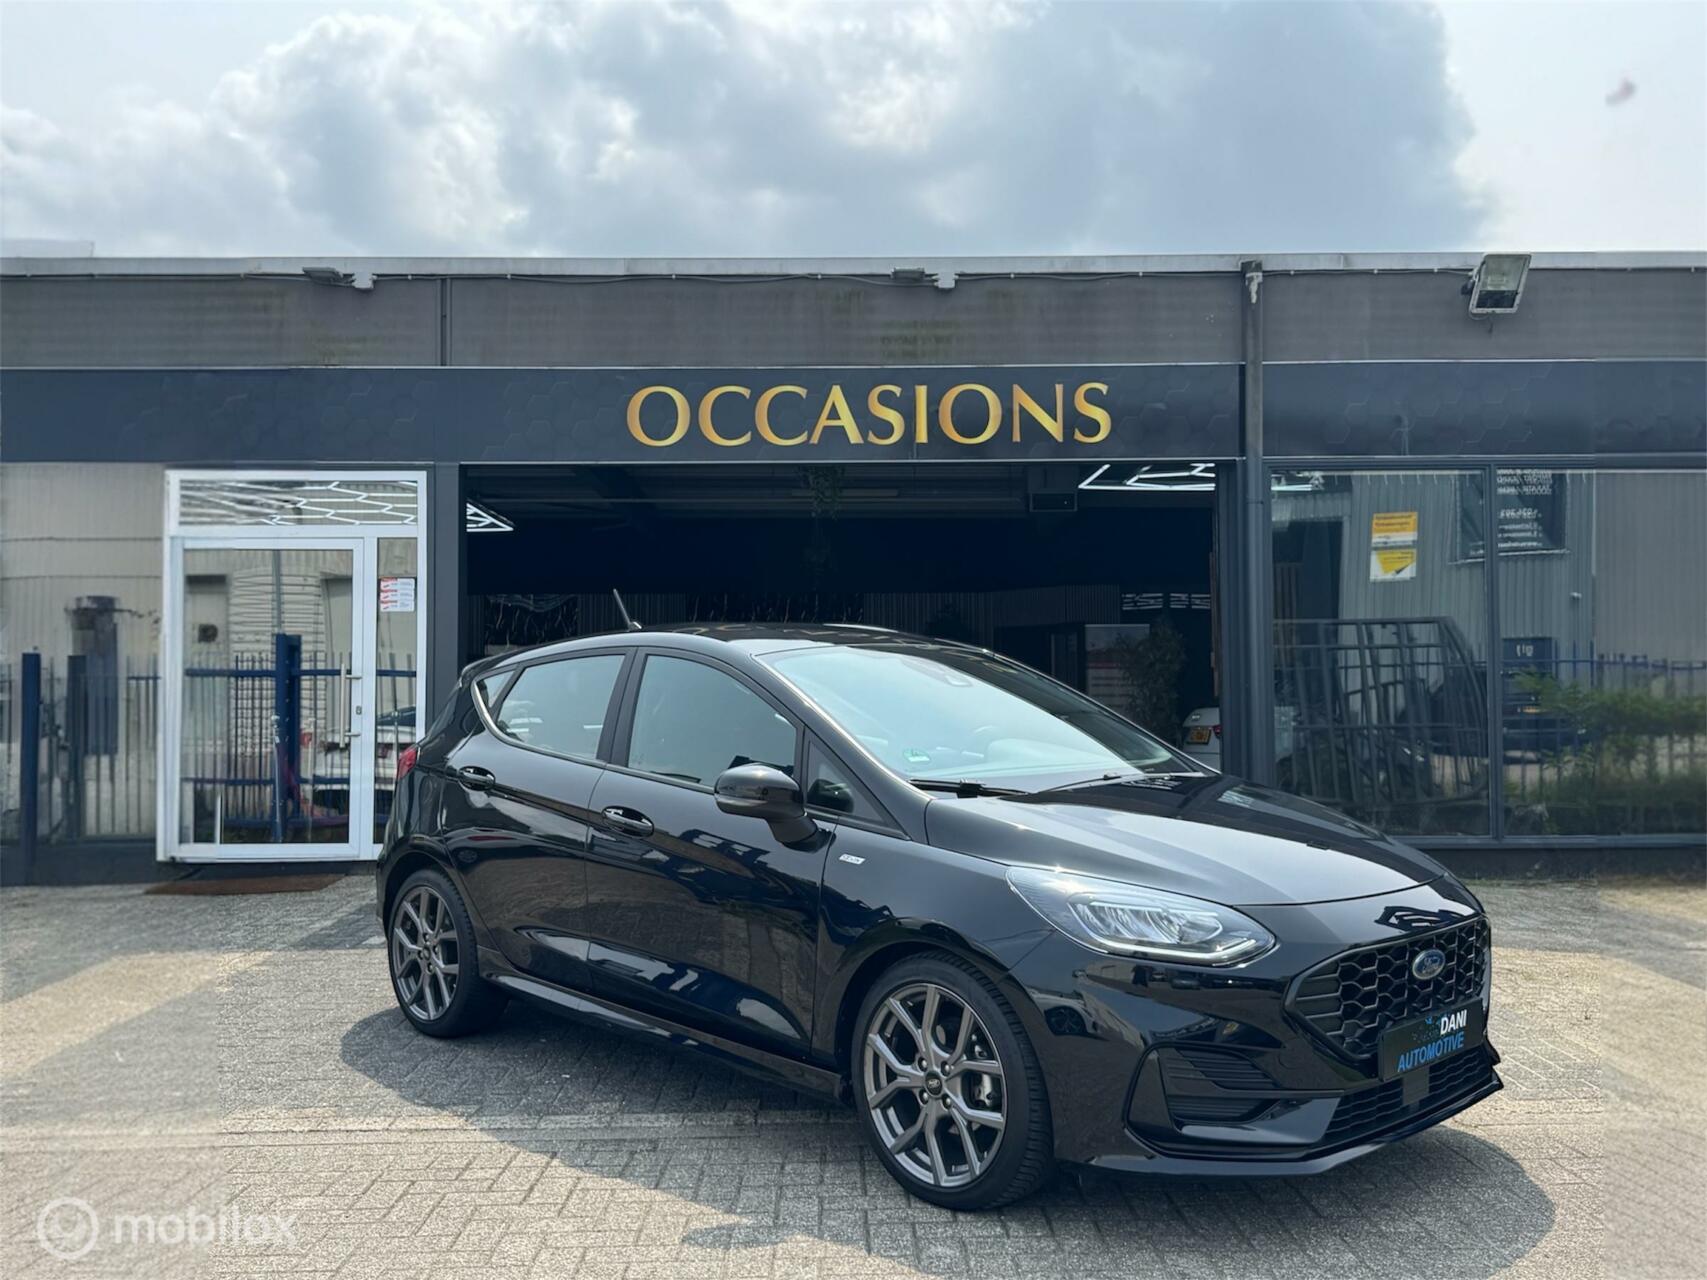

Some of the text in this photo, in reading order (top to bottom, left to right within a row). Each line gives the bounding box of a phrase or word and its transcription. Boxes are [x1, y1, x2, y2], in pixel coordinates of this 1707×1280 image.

[626, 382, 1112, 447] OCCASIONS
[1440, 1009, 1467, 1035] DANI
[1397, 1031, 1465, 1072] AUTOMOTIVE
